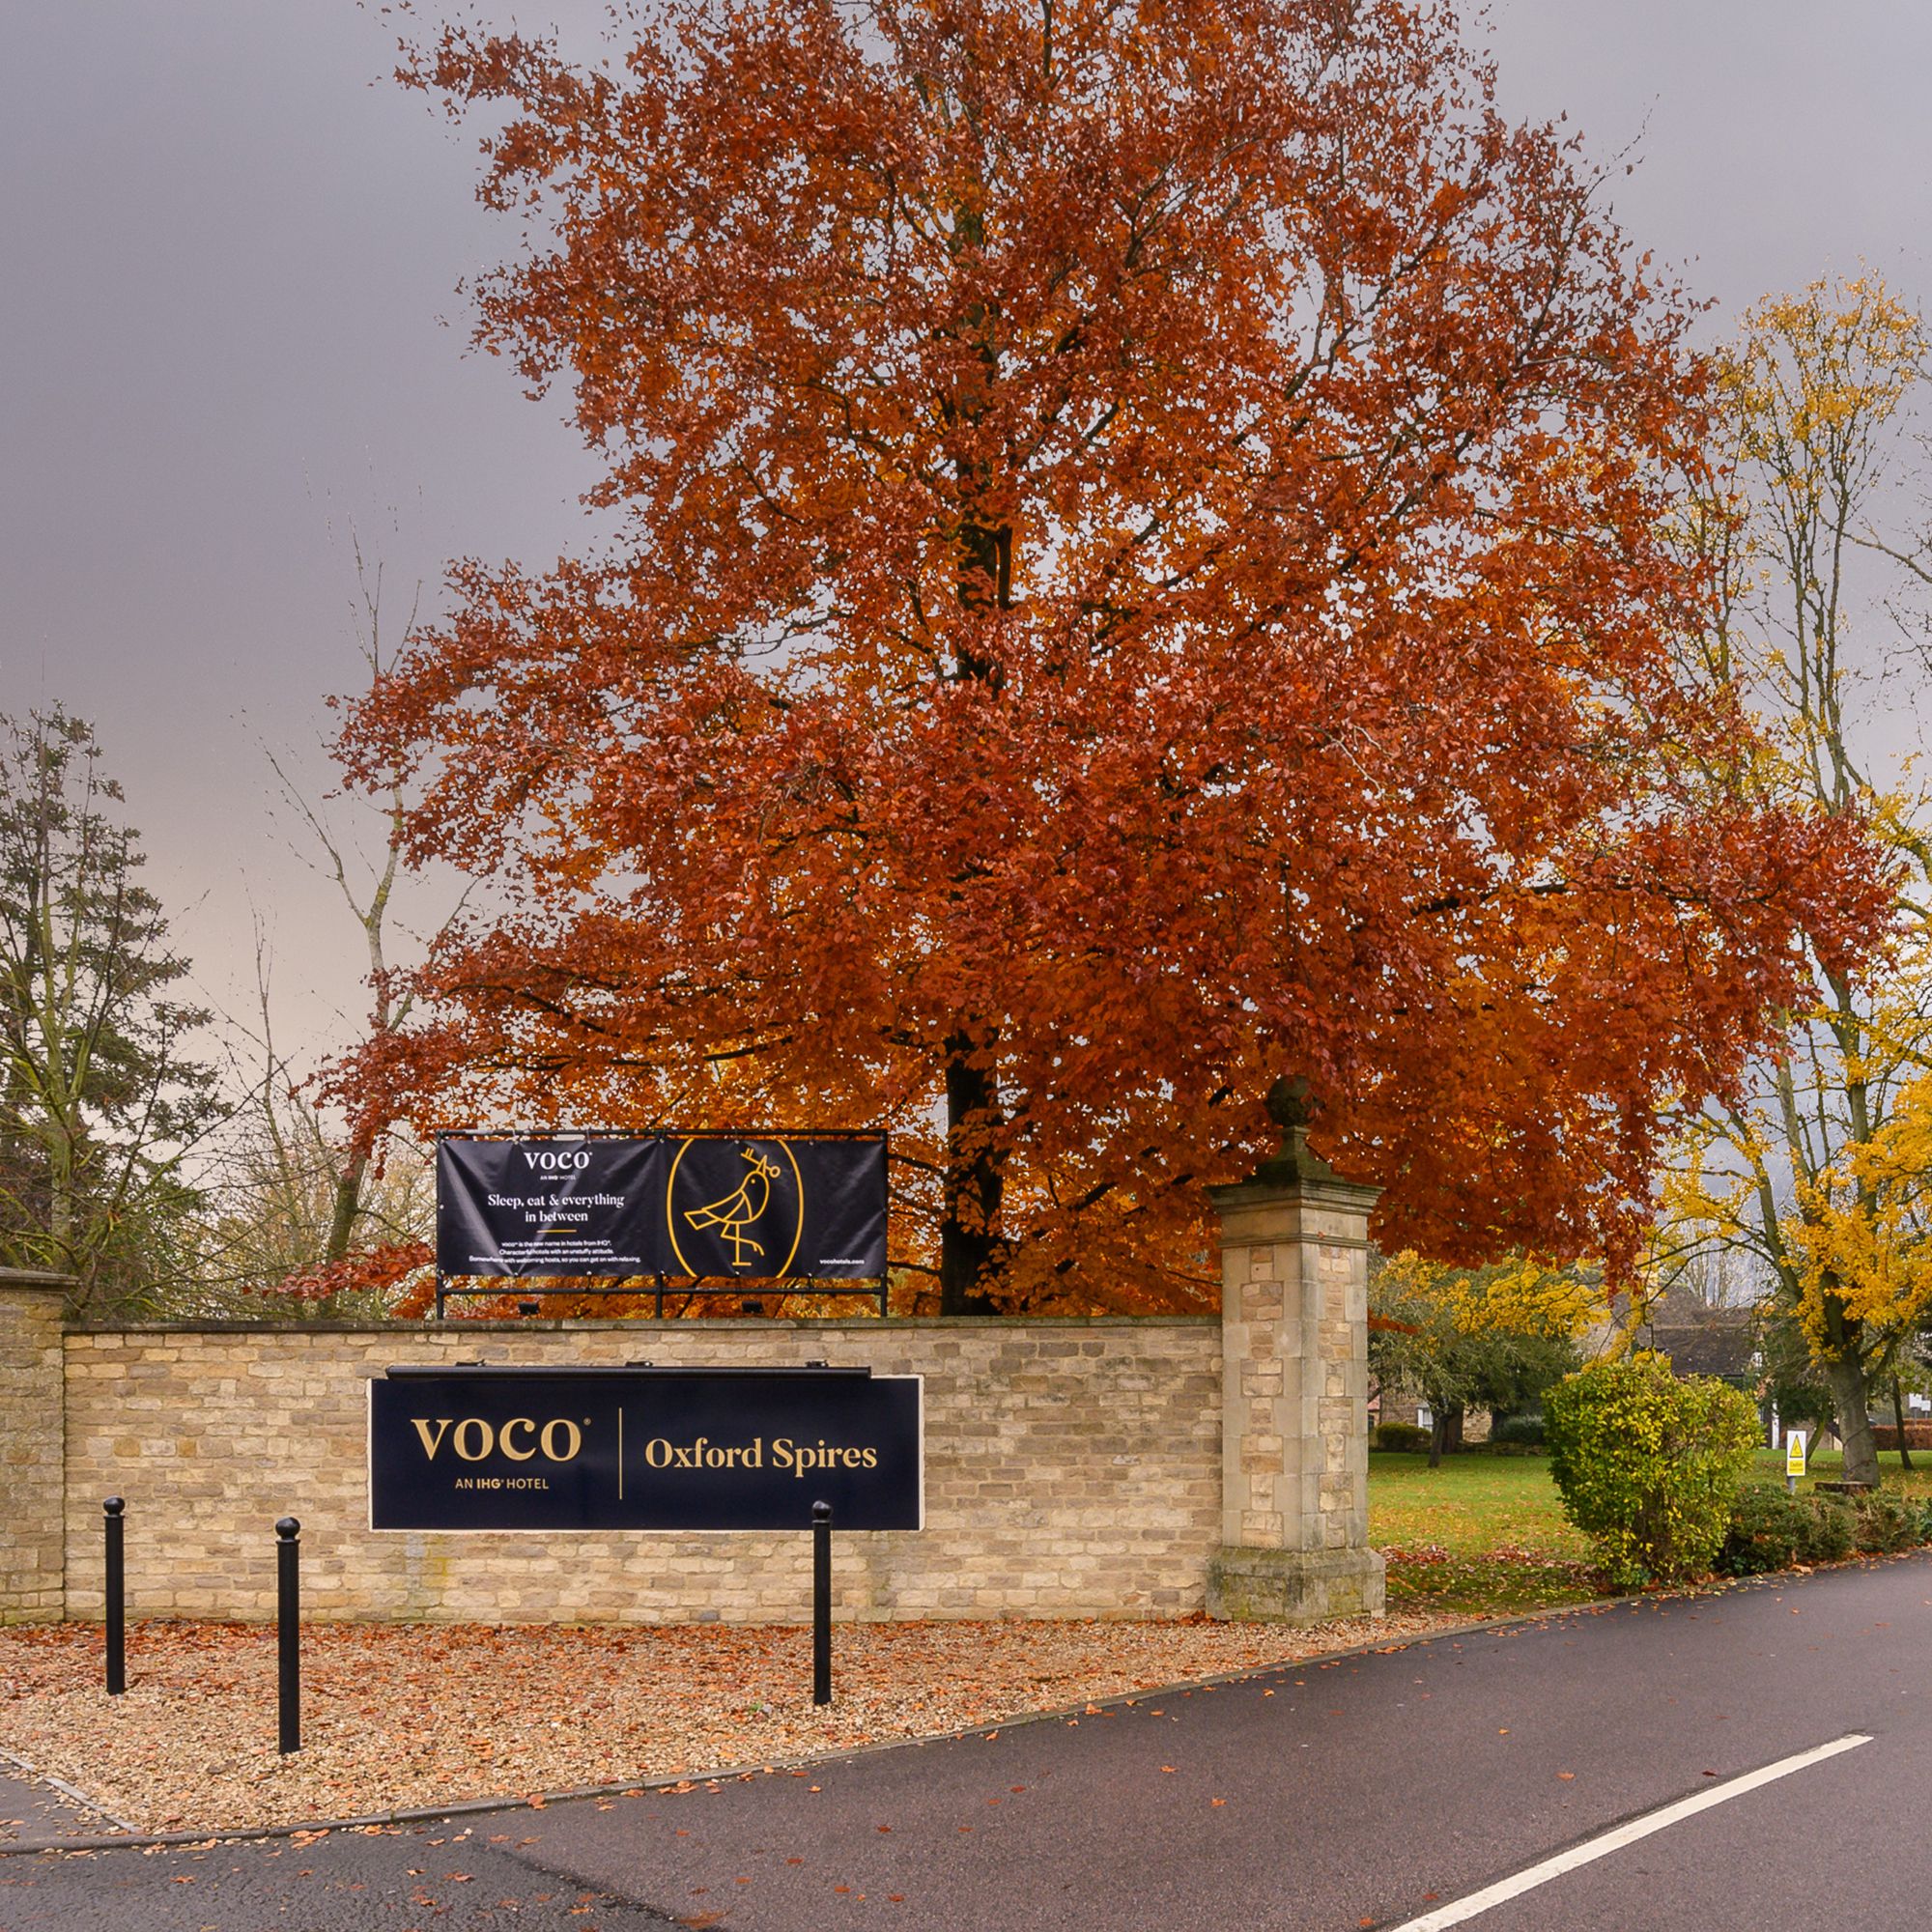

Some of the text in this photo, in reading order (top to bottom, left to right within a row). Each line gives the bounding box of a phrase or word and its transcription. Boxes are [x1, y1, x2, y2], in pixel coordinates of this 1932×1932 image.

[488, 1193, 625, 1209] Sleep, eat & everything
[525, 1209, 588, 1222] in between
[644, 1436, 879, 1478] Oxford Spires
[455, 1478, 473, 1489] AN
[506, 1478, 550, 1490] HOTEL
